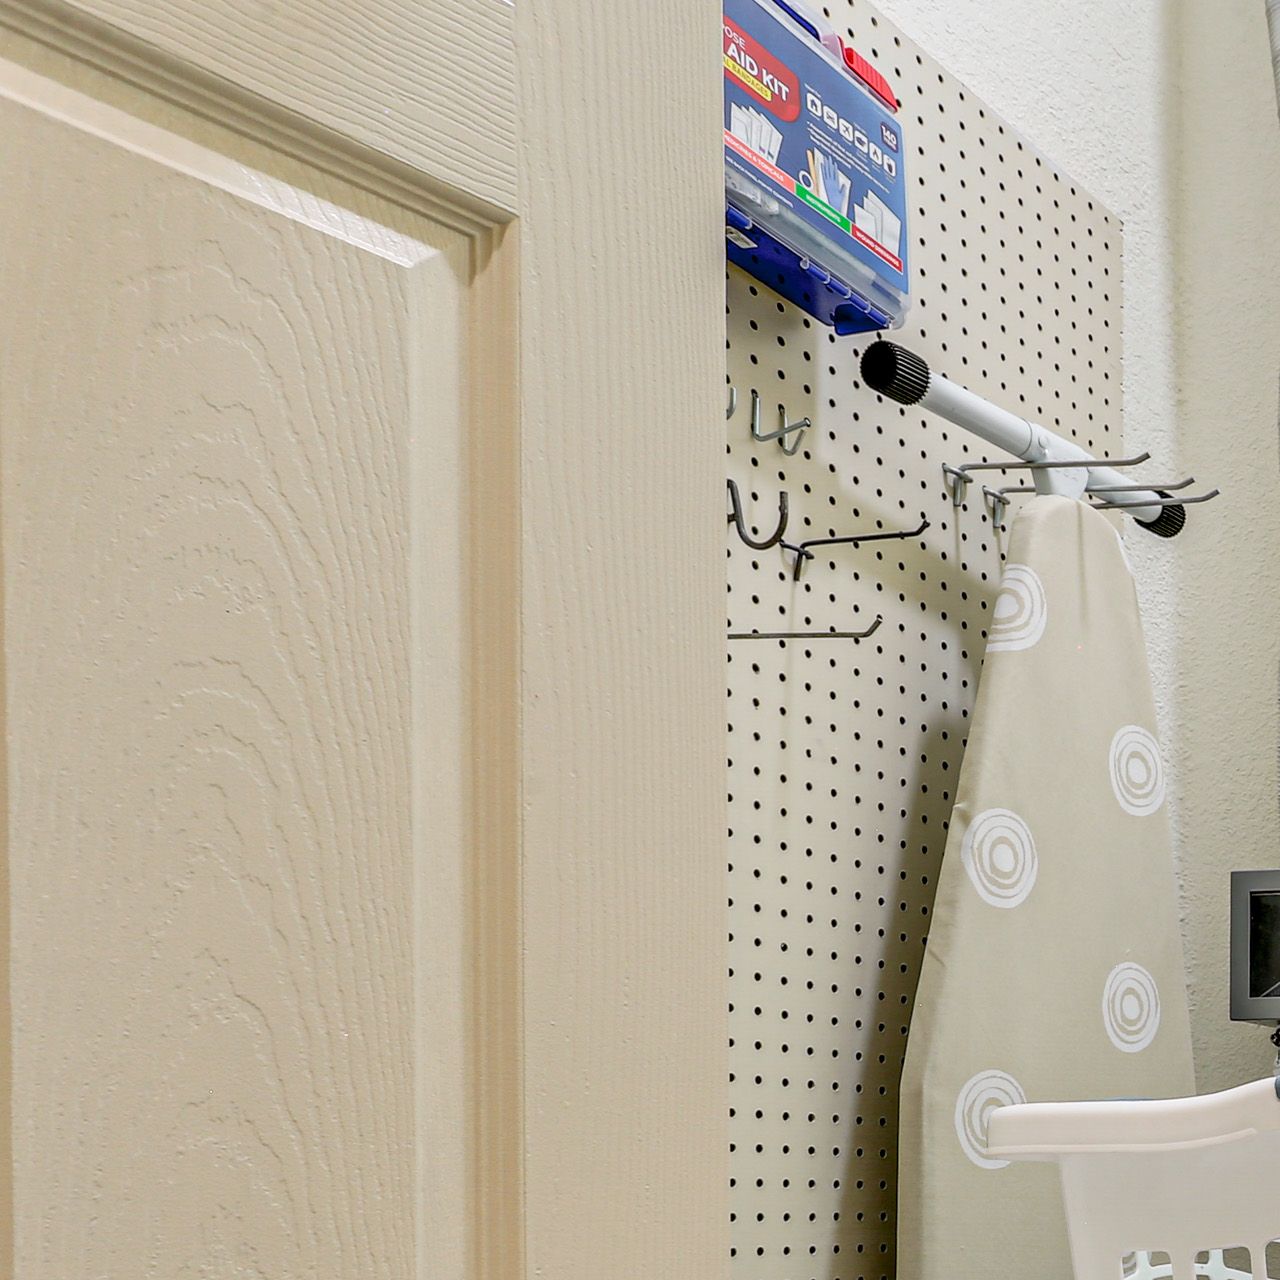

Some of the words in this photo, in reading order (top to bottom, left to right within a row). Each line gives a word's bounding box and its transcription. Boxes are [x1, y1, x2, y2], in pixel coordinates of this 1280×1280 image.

[725, 26, 746, 50] OSE
[727, 42, 758, 76] AID
[762, 68, 790, 101] KIT
